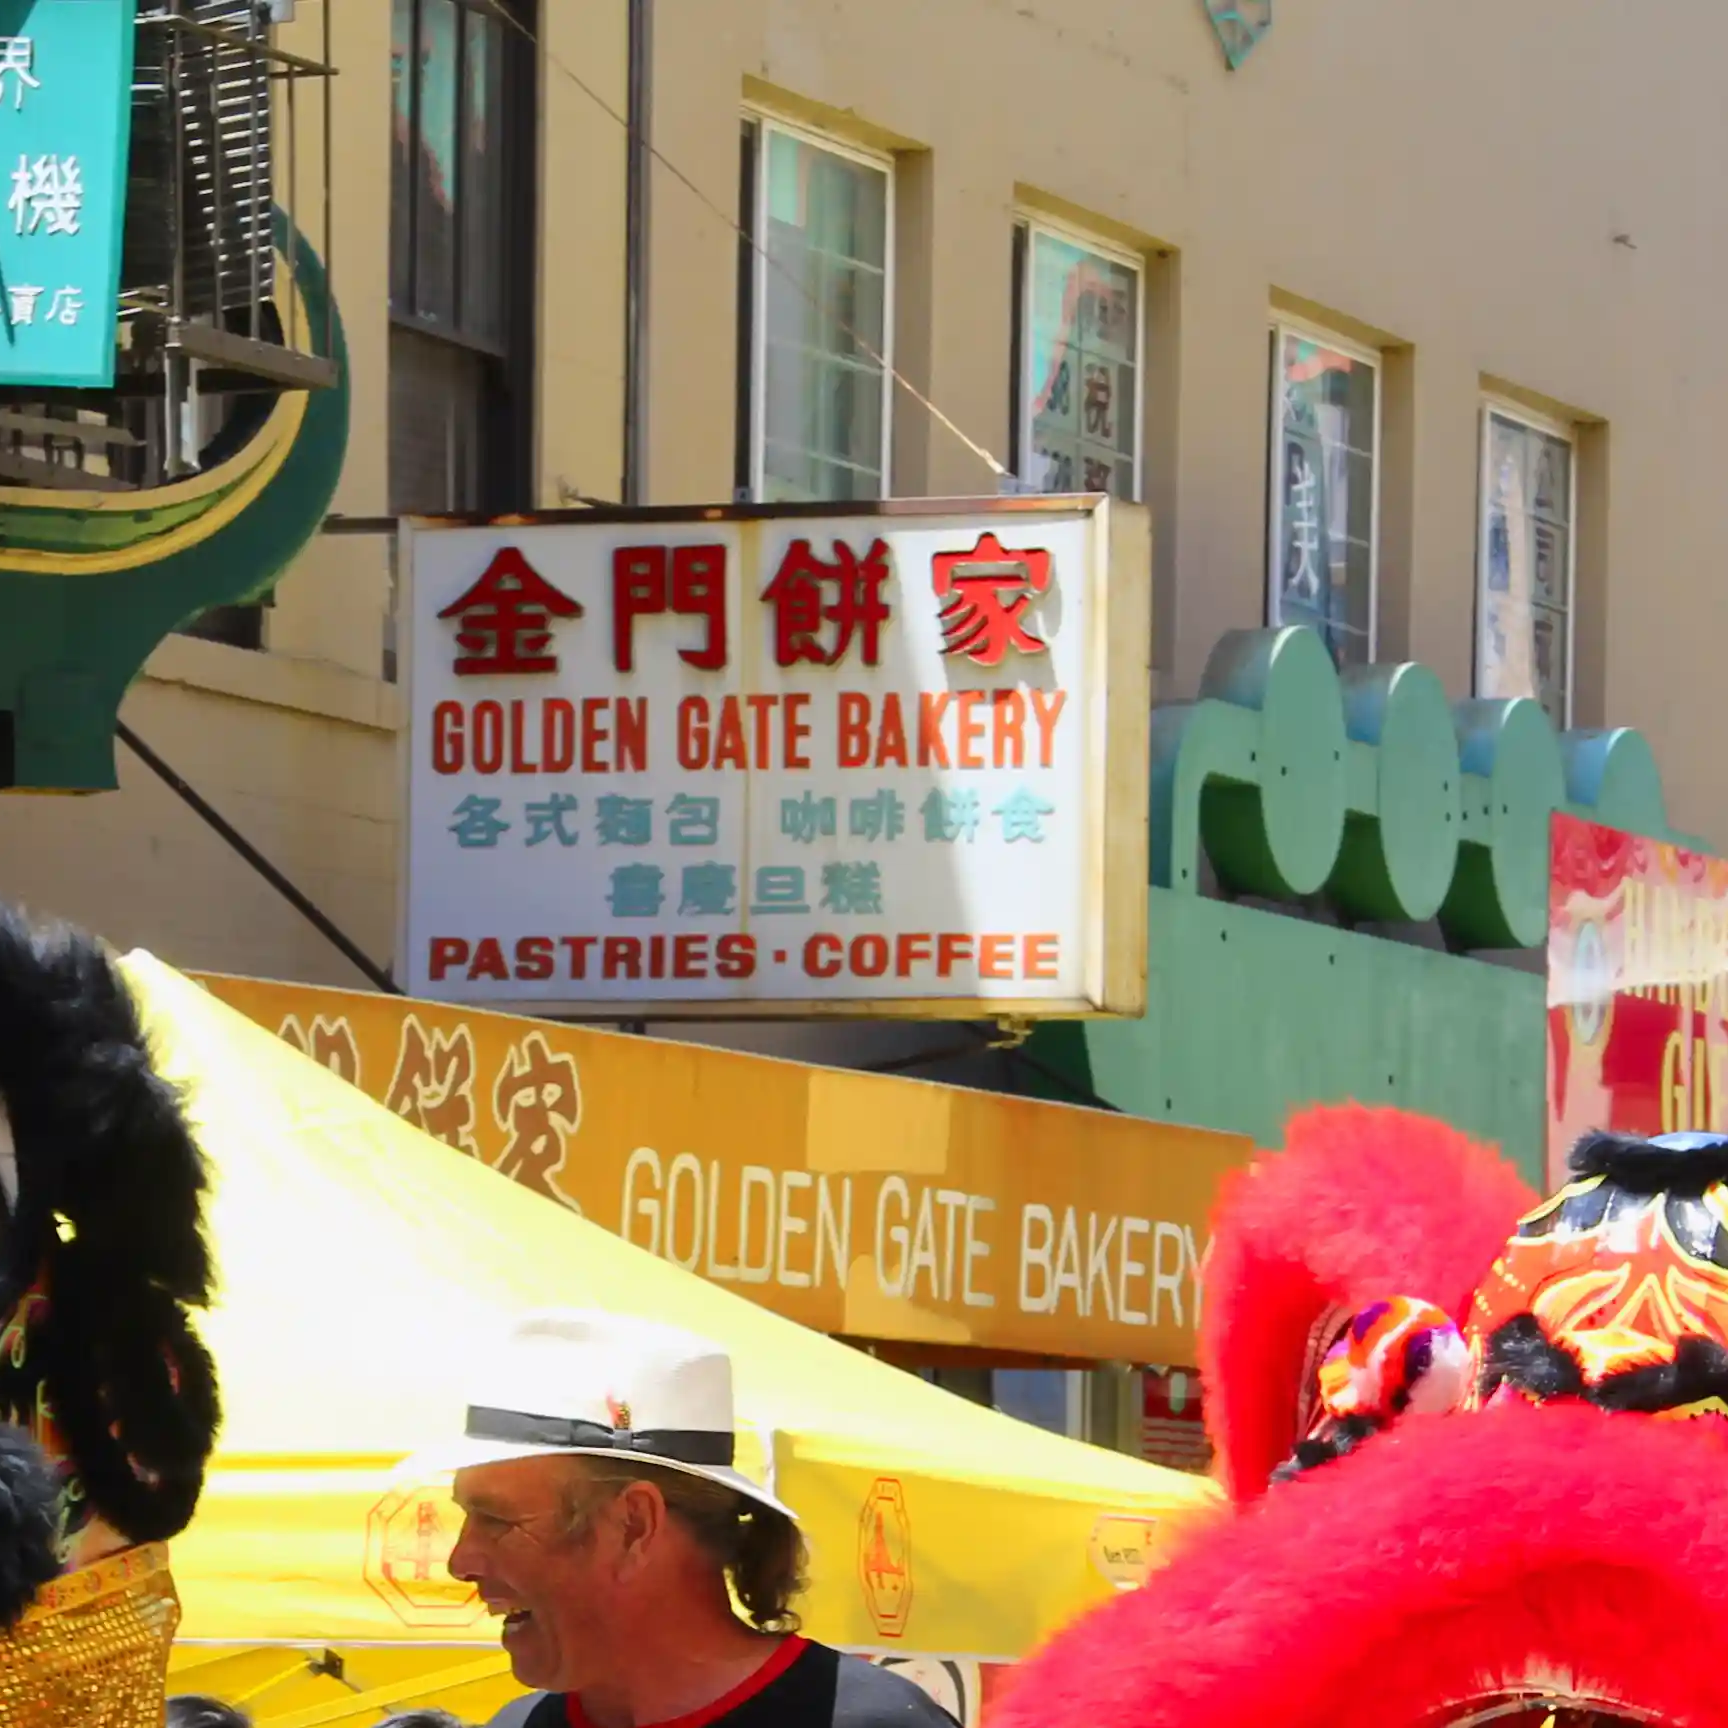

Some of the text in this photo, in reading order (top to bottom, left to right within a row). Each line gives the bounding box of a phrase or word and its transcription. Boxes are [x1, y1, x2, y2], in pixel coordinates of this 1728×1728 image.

[438, 531, 1054, 676] 金門餅家
[431, 688, 1067, 776] GOLDEN GATE BAKERY
[427, 931, 1060, 982] PASTRIES COFFEE
[619, 1145, 1215, 1330] GOLDEN GATE BAKERY
